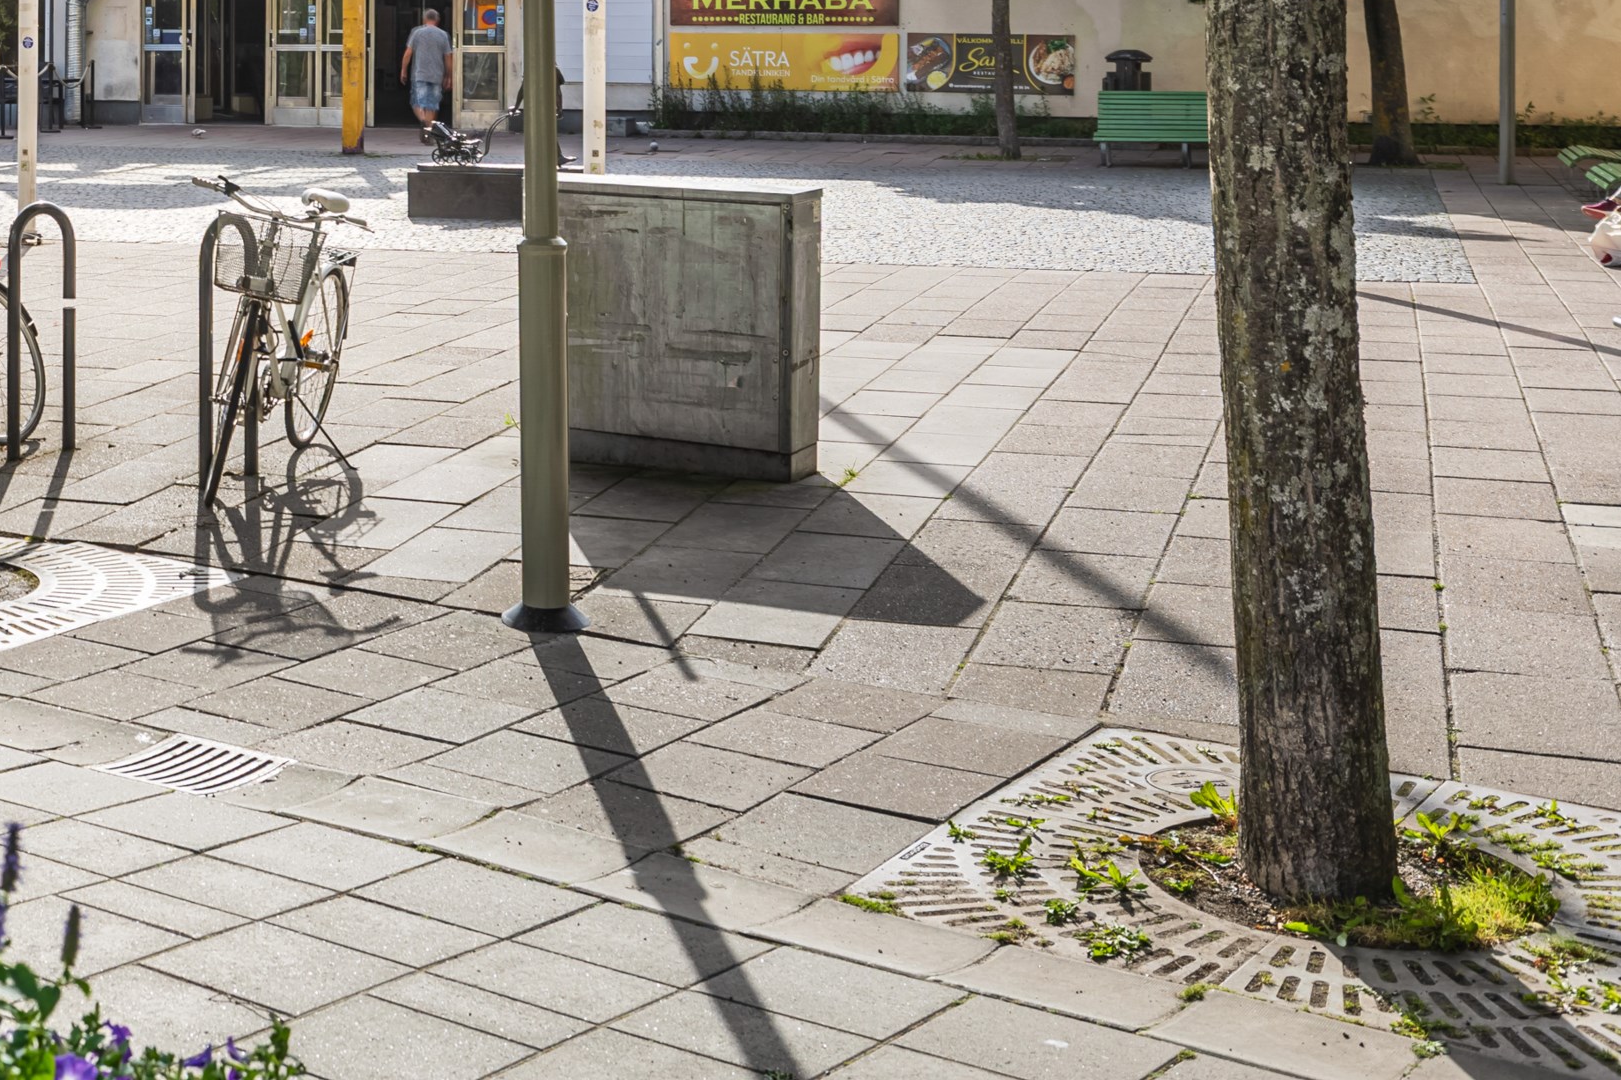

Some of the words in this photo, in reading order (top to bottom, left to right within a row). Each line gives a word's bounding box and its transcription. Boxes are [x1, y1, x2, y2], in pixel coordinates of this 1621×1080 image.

[739, 13, 796, 25] RESTAURANG
[797, 14, 805, 25] &
[806, 13, 825, 25] BAR
[729, 47, 790, 68] SÄTRA
